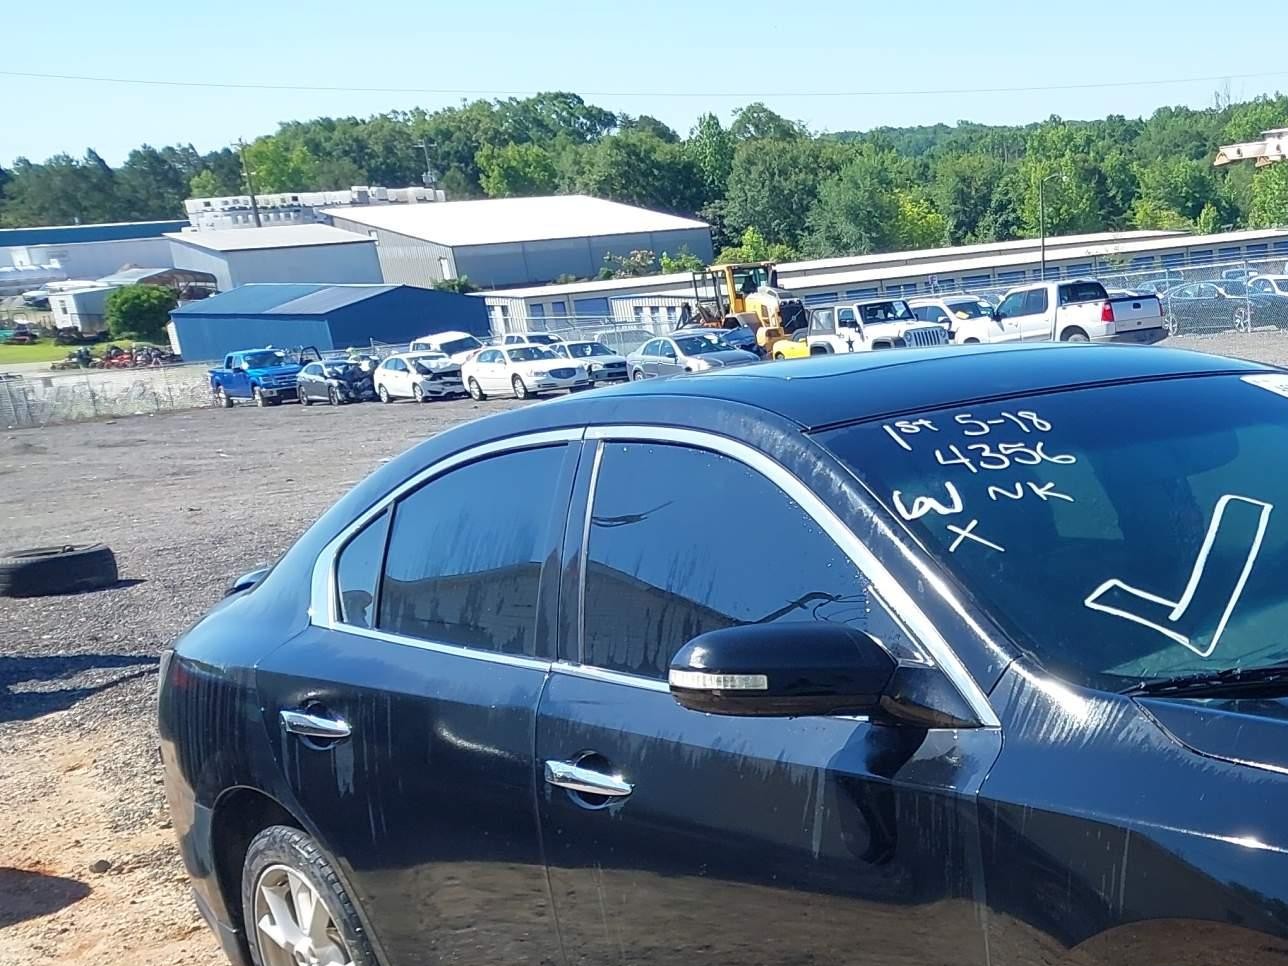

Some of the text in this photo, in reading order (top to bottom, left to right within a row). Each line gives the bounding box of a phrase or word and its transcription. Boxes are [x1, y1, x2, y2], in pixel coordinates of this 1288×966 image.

[954, 410, 1052, 436] 5-18
[934, 441, 1077, 473] 4356
[987, 481, 1075, 502] NK
